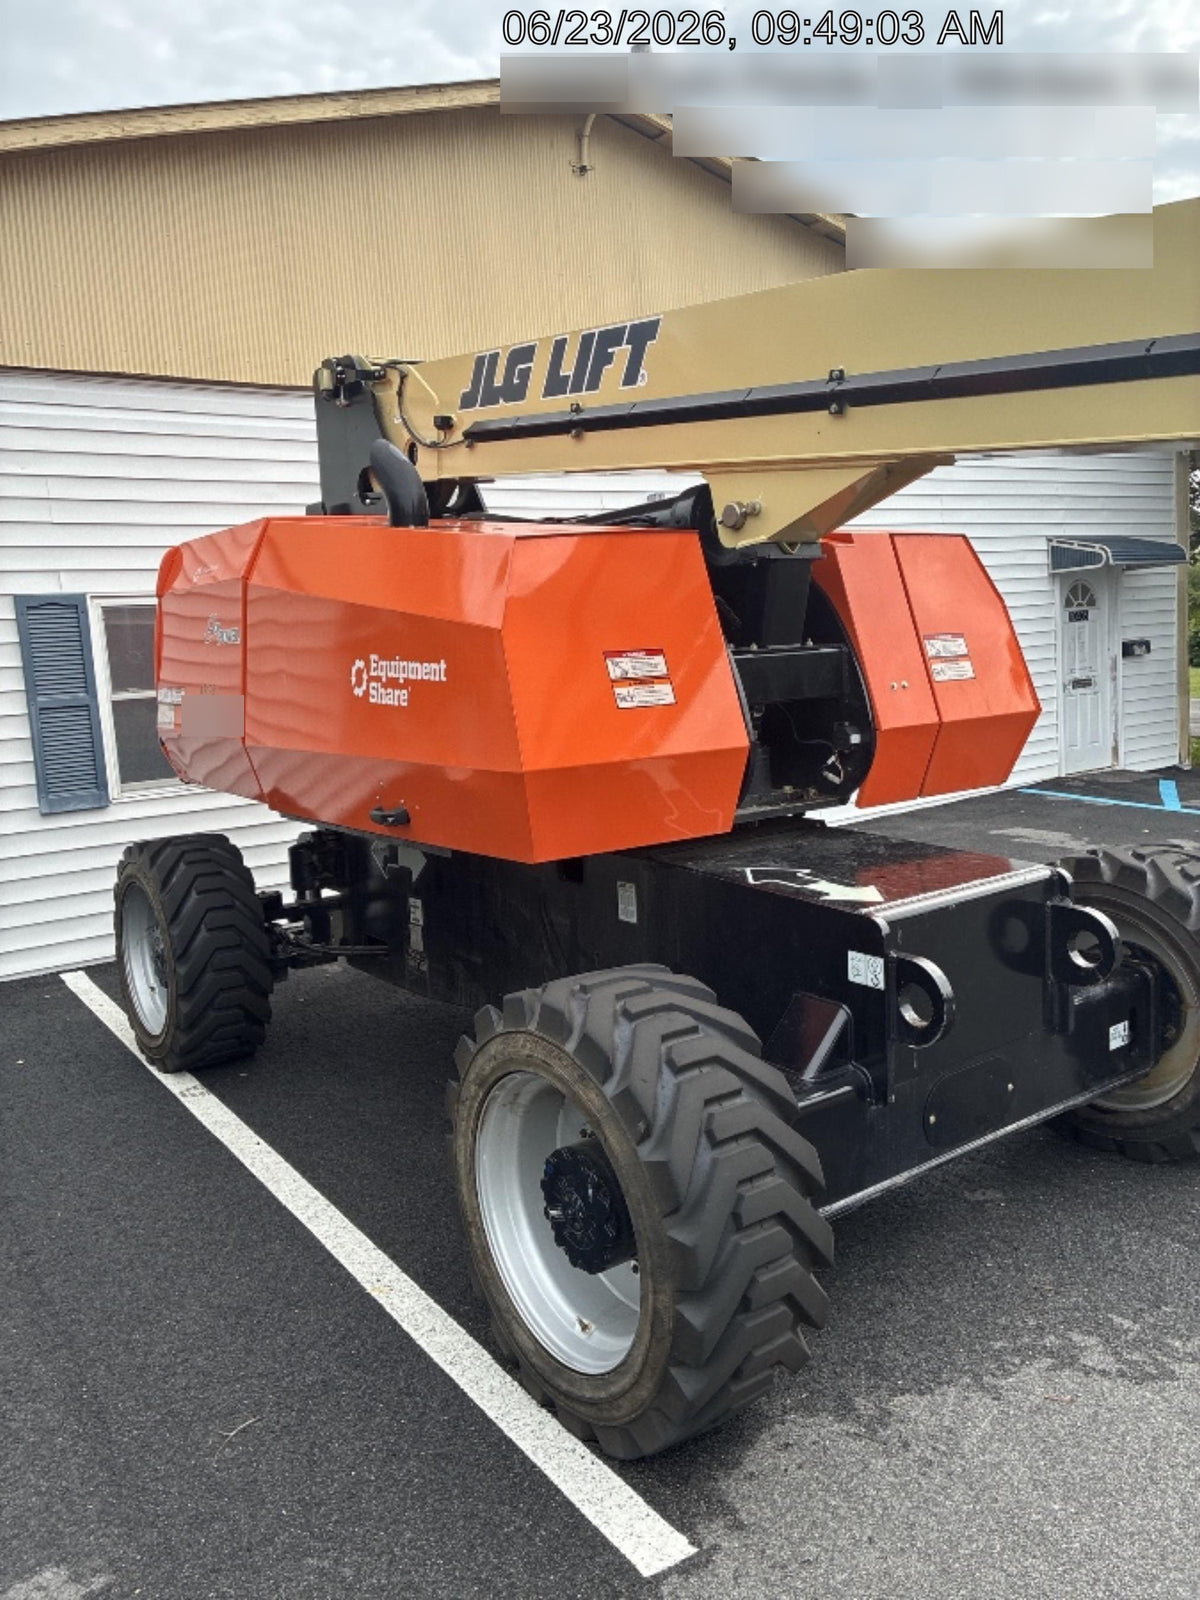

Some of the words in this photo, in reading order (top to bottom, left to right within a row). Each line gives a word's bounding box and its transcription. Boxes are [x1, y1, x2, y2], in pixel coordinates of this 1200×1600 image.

[457, 341, 539, 412] JLG
[541, 315, 663, 400] LIFT
[369, 653, 447, 683] Equipment
[369, 681, 409, 706] Share
